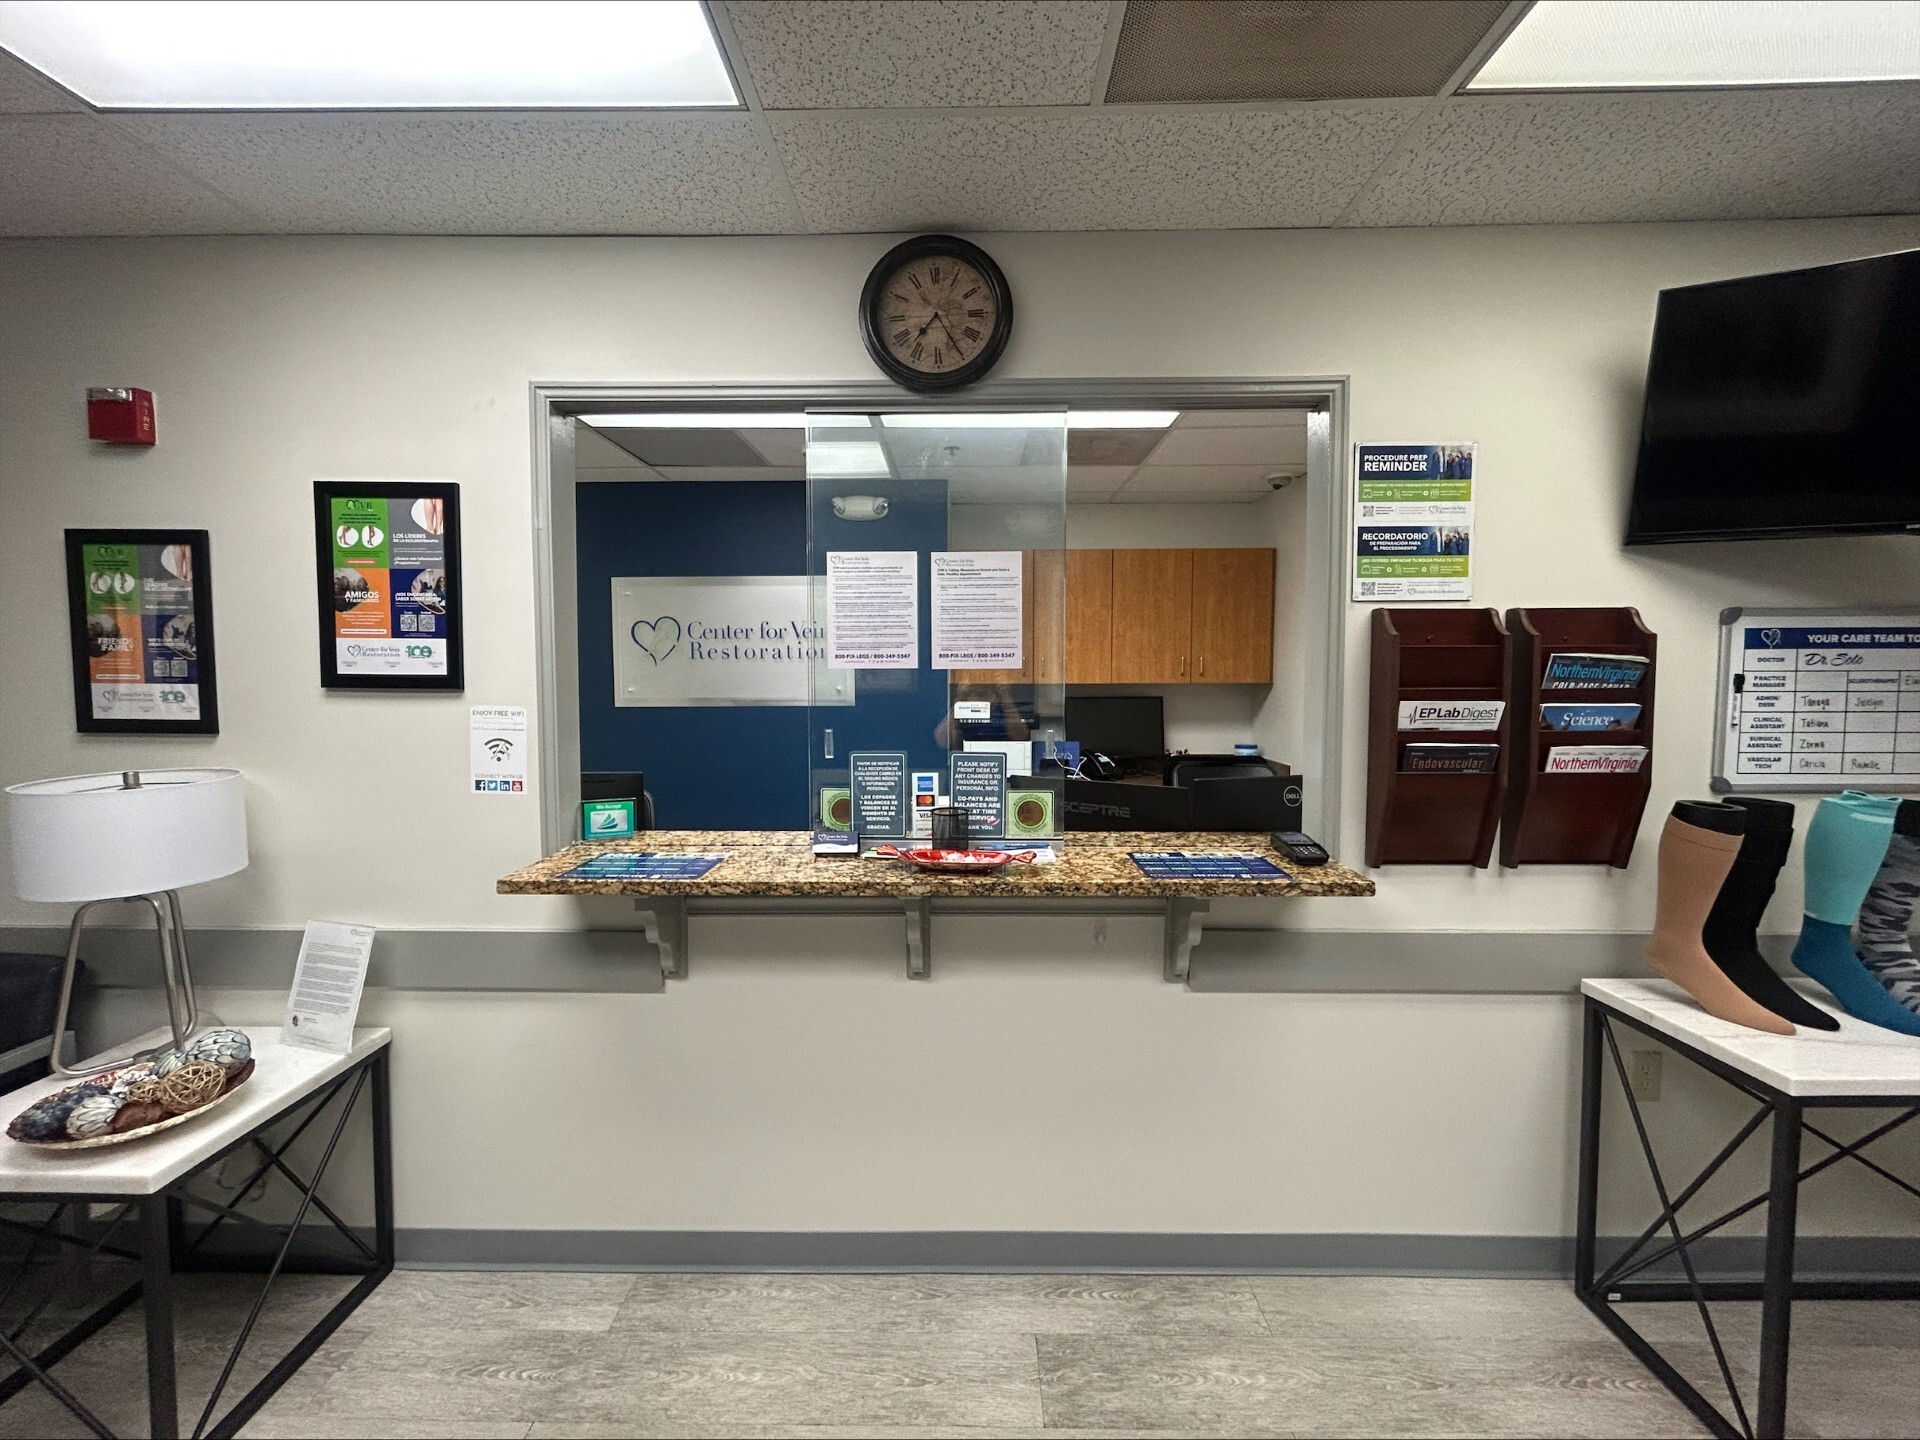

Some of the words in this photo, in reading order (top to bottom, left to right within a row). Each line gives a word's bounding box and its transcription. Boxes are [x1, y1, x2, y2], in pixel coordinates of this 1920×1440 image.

[1364, 461, 1428, 472] REMINDER
[1362, 532, 1429, 540] RECORDATORIO
[687, 621, 754, 640] Center
[760, 621, 787, 640] for
[1808, 634, 1840, 643] YOUR
[1841, 634, 1871, 643] CARE
[1874, 634, 1904, 643] TEAM
[1804, 653, 1828, 666] Dr.
[1560, 712, 1614, 726] Science
[1412, 758, 1484, 769] Endovascular
[1062, 801, 1131, 818] SCEPTRE
